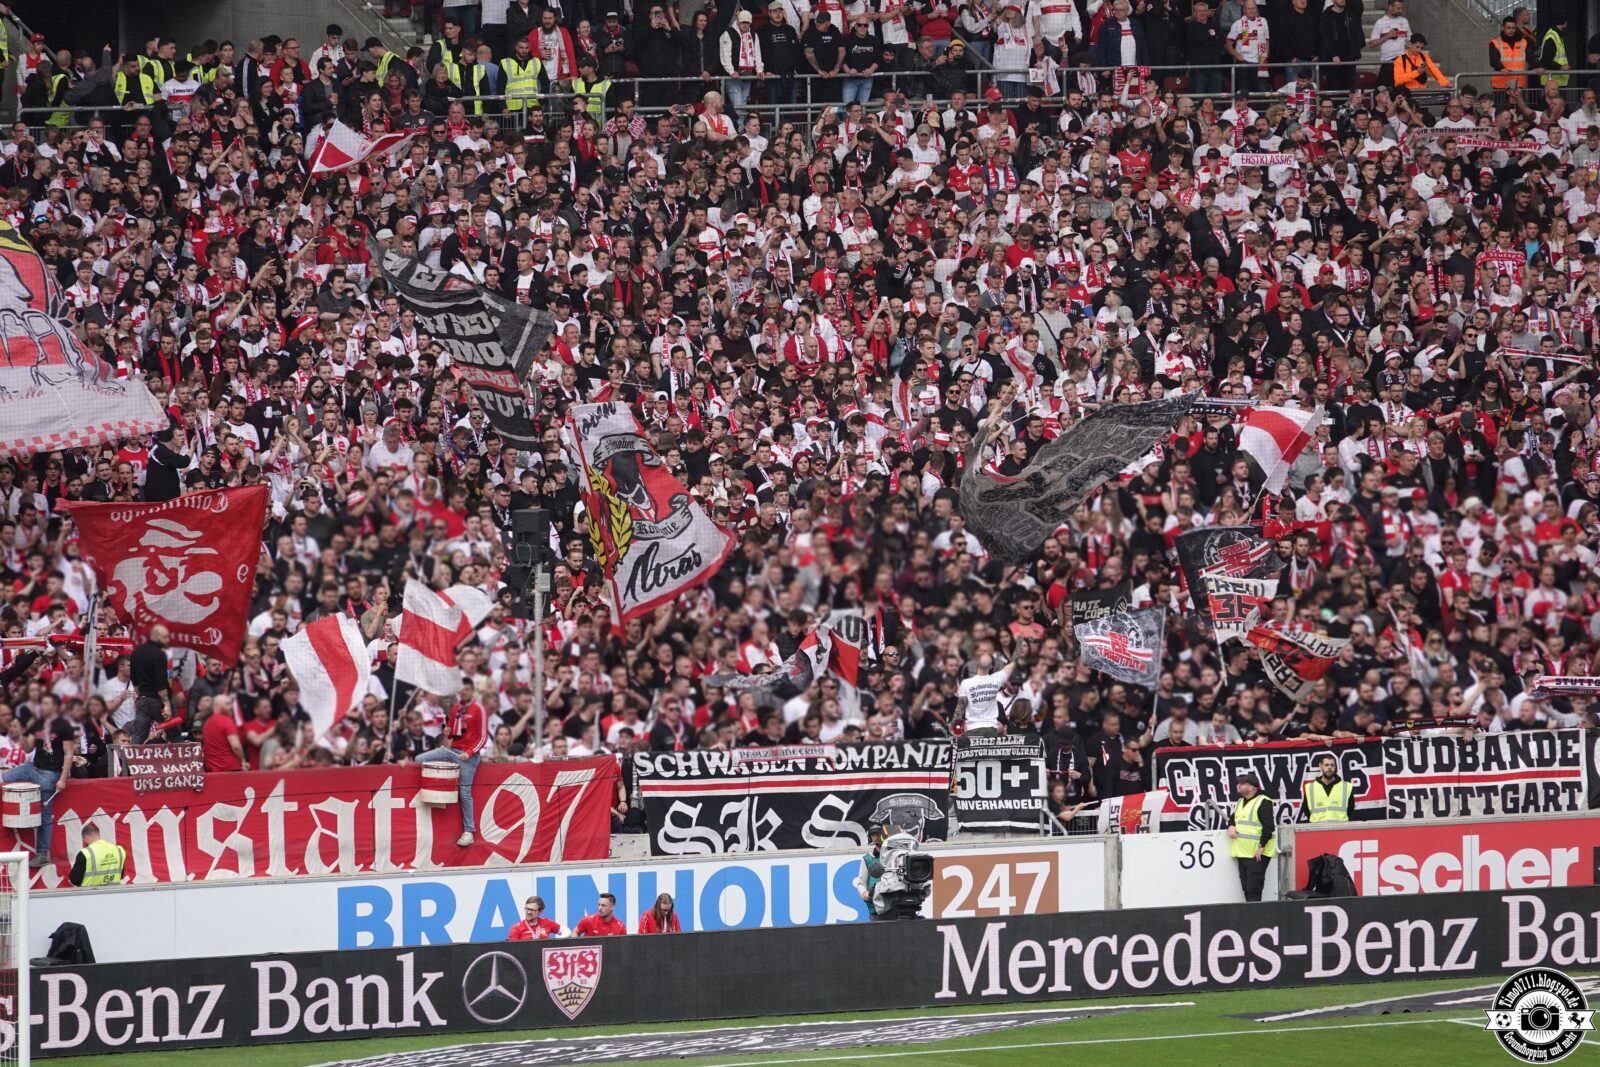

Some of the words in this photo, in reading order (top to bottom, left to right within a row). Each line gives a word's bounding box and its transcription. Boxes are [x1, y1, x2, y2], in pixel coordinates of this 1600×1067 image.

[1241, 154, 1293, 166] ERSTKLASSIG
[1084, 607, 1110, 619] COPS
[124, 747, 173, 760] ULTRA
[177, 745, 202, 759] IST
[815, 740, 951, 773] KOMPANIE
[969, 737, 994, 747] EHRE
[996, 736, 1026, 746] ALLEN
[128, 763, 158, 776] DER
[133, 777, 162, 791] UMS
[956, 760, 1049, 799] 50+1
[480, 768, 596, 864] 97
[1388, 781, 1582, 819] STUTTGART
[1179, 840, 1214, 870] 36
[1338, 834, 1580, 896] fischer
[337, 859, 871, 950] BRAINHOUS
[941, 861, 1050, 919] 247
[935, 905, 1478, 998] Mercedes-Benz
[1501, 894, 1600, 968] Ba
[250, 951, 447, 1037] Bank
